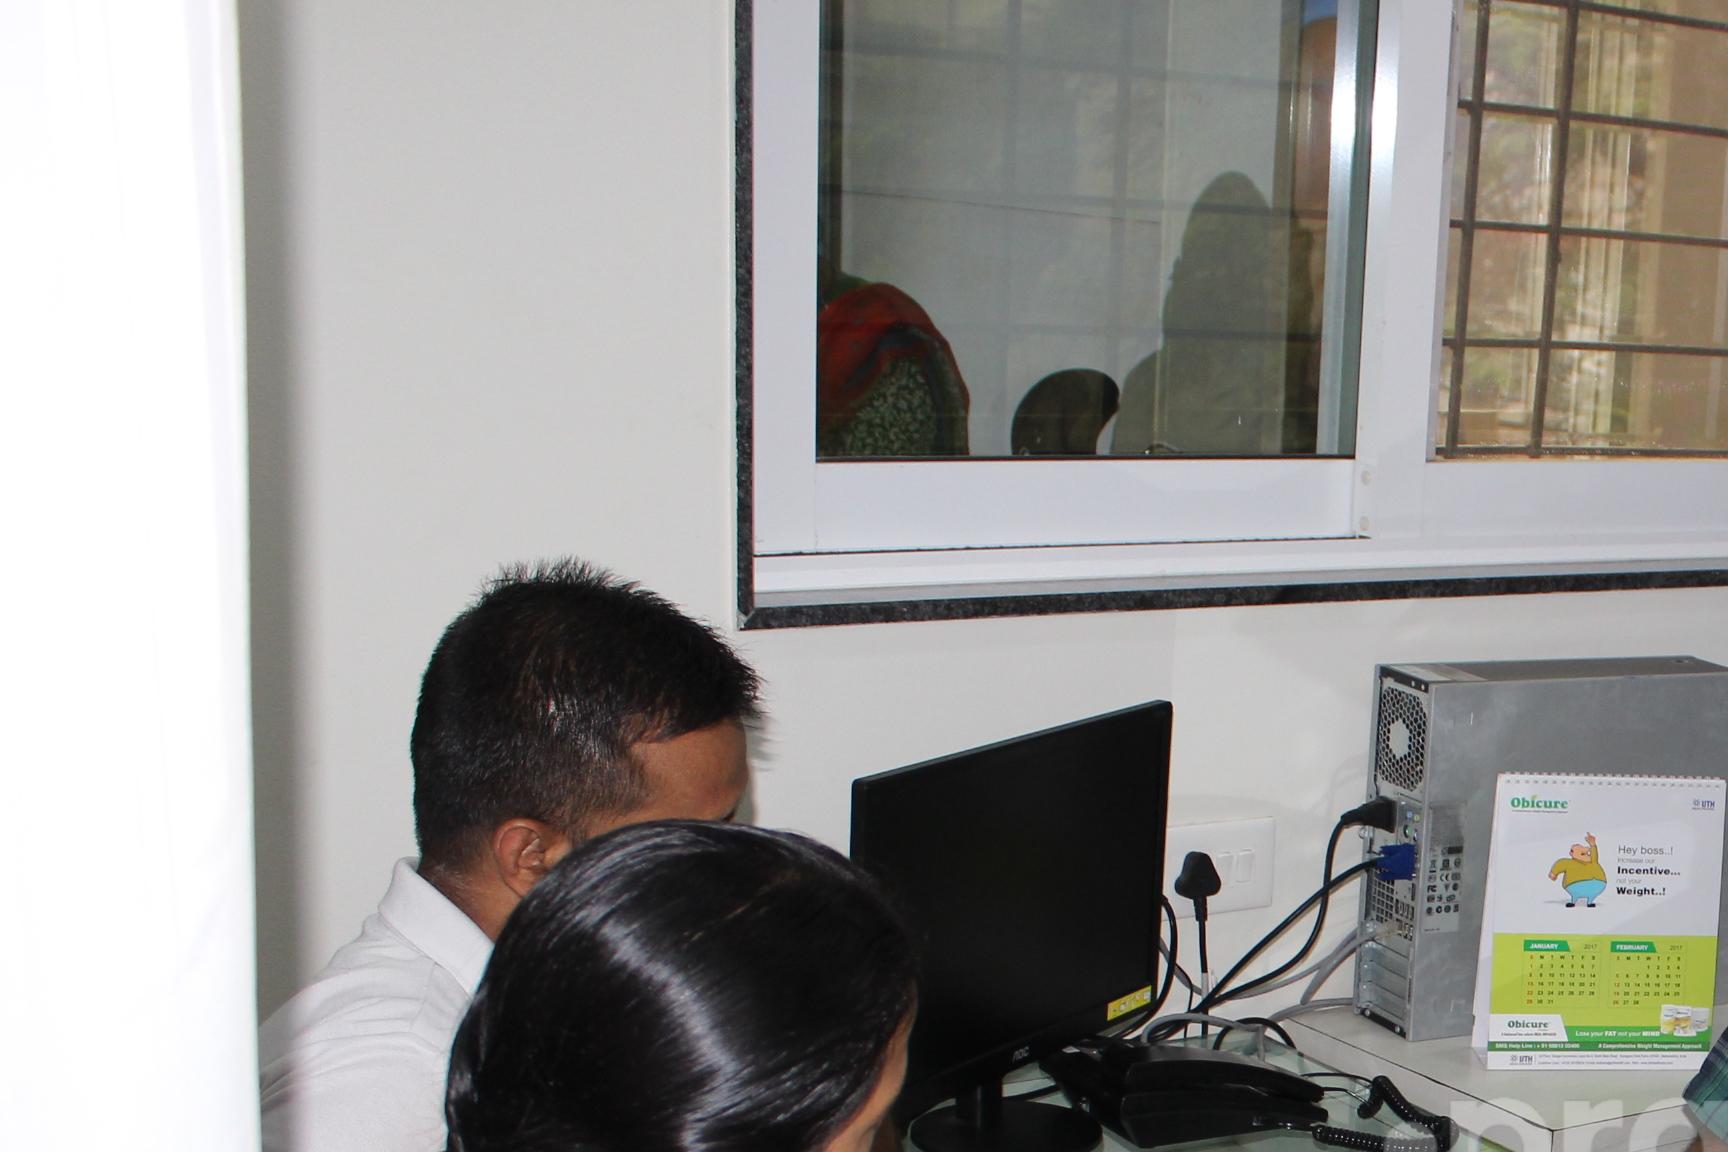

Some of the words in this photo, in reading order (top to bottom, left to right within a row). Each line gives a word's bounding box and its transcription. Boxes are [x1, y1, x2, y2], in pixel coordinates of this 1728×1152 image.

[1511, 795, 1569, 809] Obicure
[1618, 845, 1638, 856] Hey
[1616, 886, 1666, 897] Weight..!
[1508, 1020, 1548, 1028] Obicure
